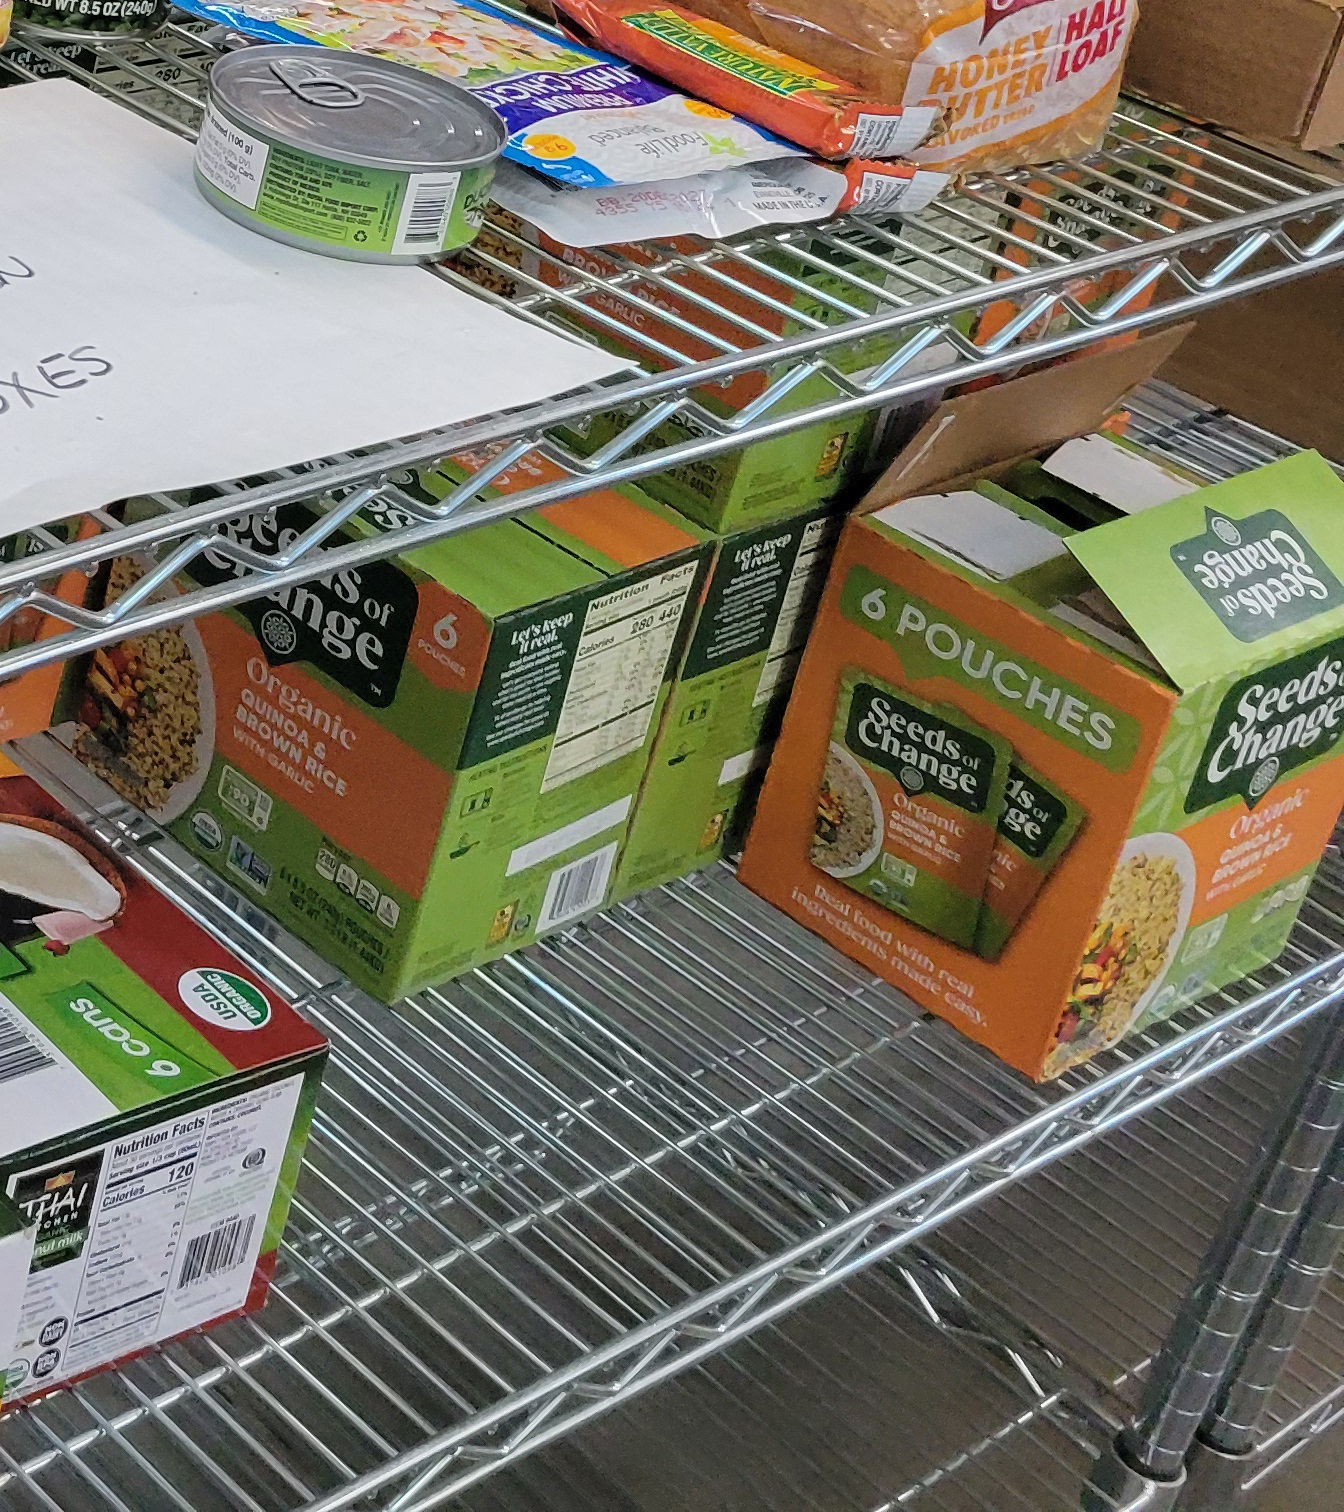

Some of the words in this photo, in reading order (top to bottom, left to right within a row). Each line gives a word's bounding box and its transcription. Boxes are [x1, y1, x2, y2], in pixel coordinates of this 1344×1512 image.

[932, 25, 1052, 91] HONEY
[1055, 28, 1125, 81] LOAF
[860, 587, 887, 620] 6
[896, 604, 1116, 751] POUCHES
[247, 657, 358, 751] Organic
[867, 698, 961, 758] Seeds
[858, 717, 978, 795] Change
[114, 1130, 169, 1160] Nutrition
[172, 1116, 205, 1142] Facts
